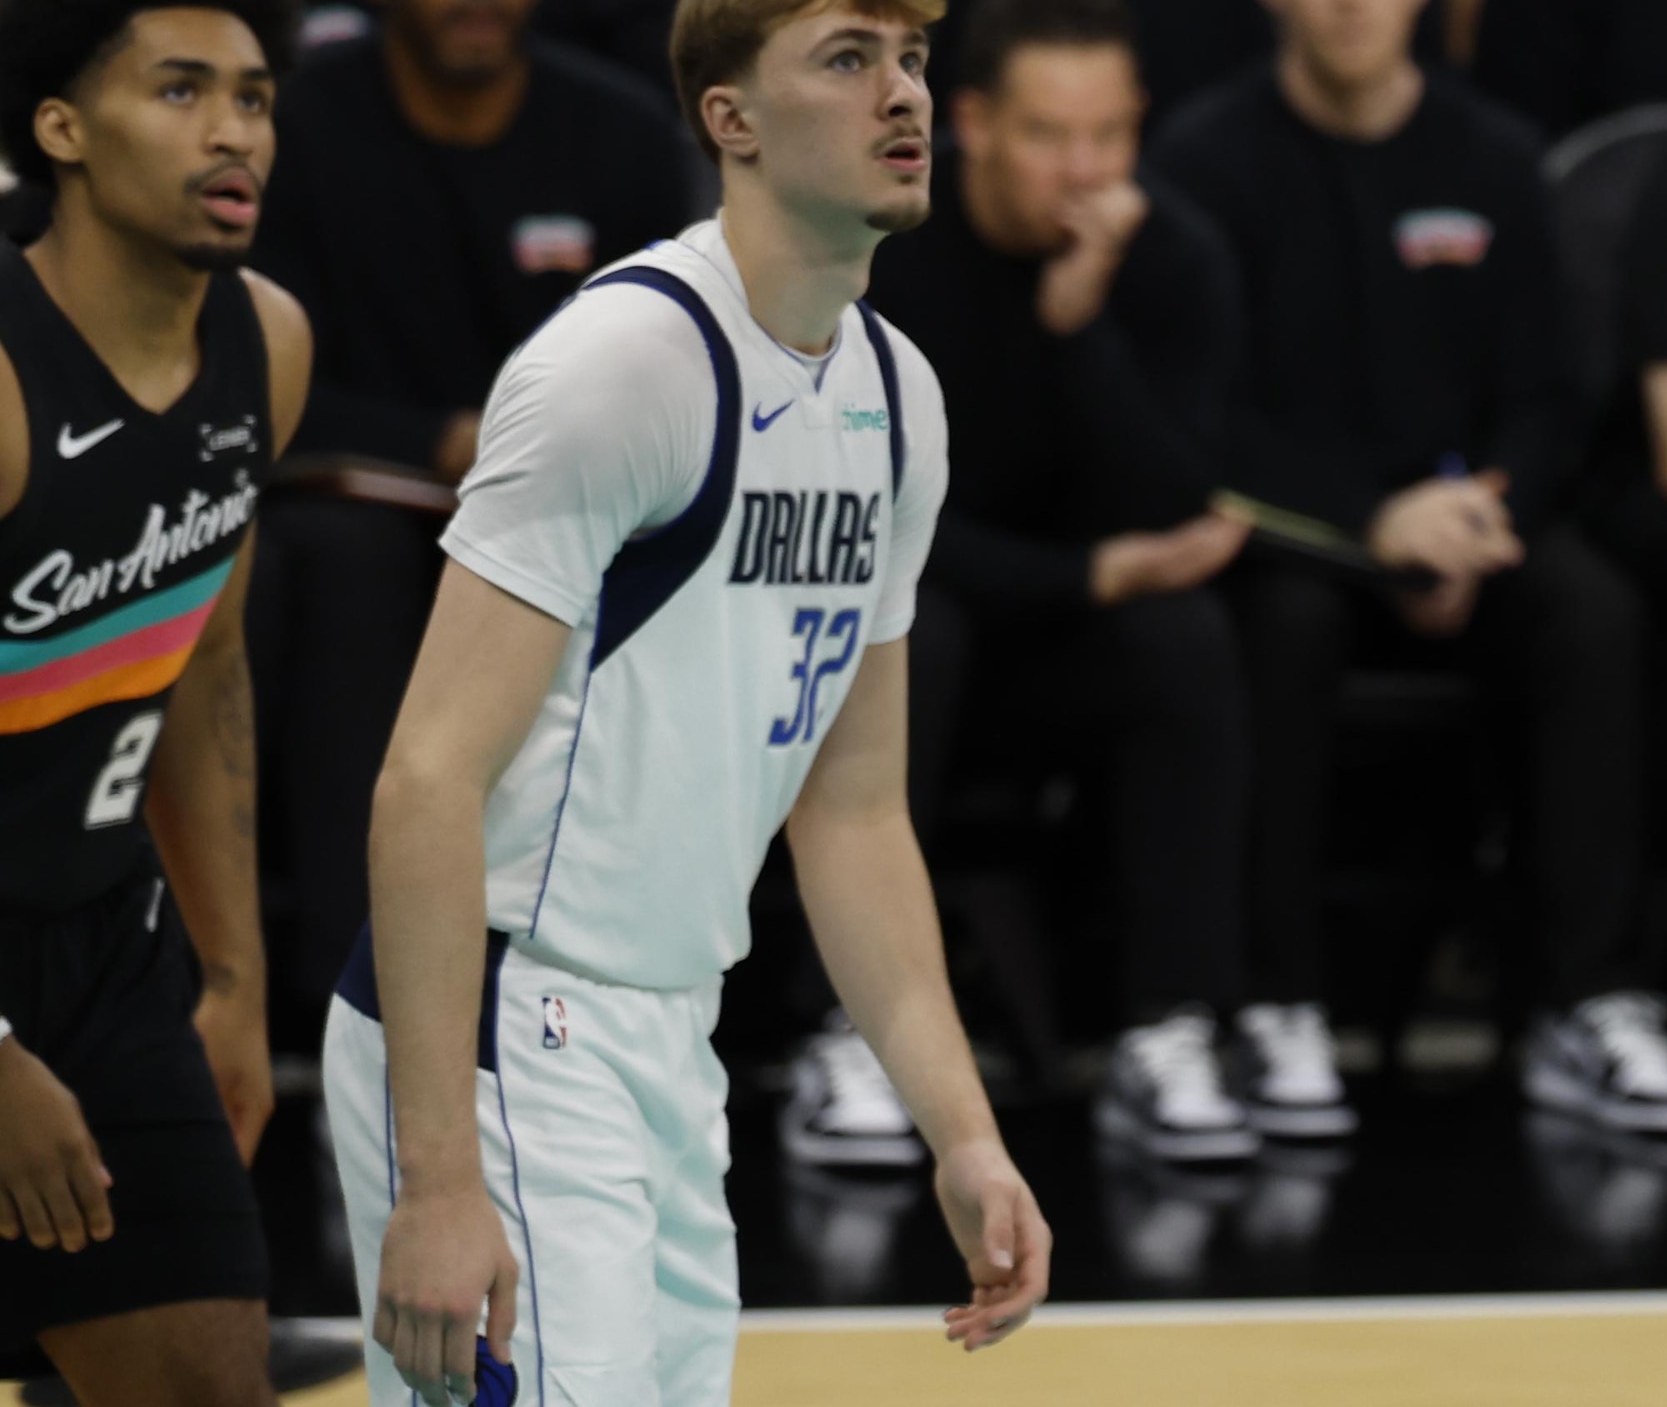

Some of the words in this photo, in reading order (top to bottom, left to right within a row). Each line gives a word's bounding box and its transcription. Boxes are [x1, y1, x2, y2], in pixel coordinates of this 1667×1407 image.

[3, 547, 114, 634] San
[727, 488, 880, 585] DALLAS
[767, 606, 862, 747] 32
[84, 709, 163, 830] 2
